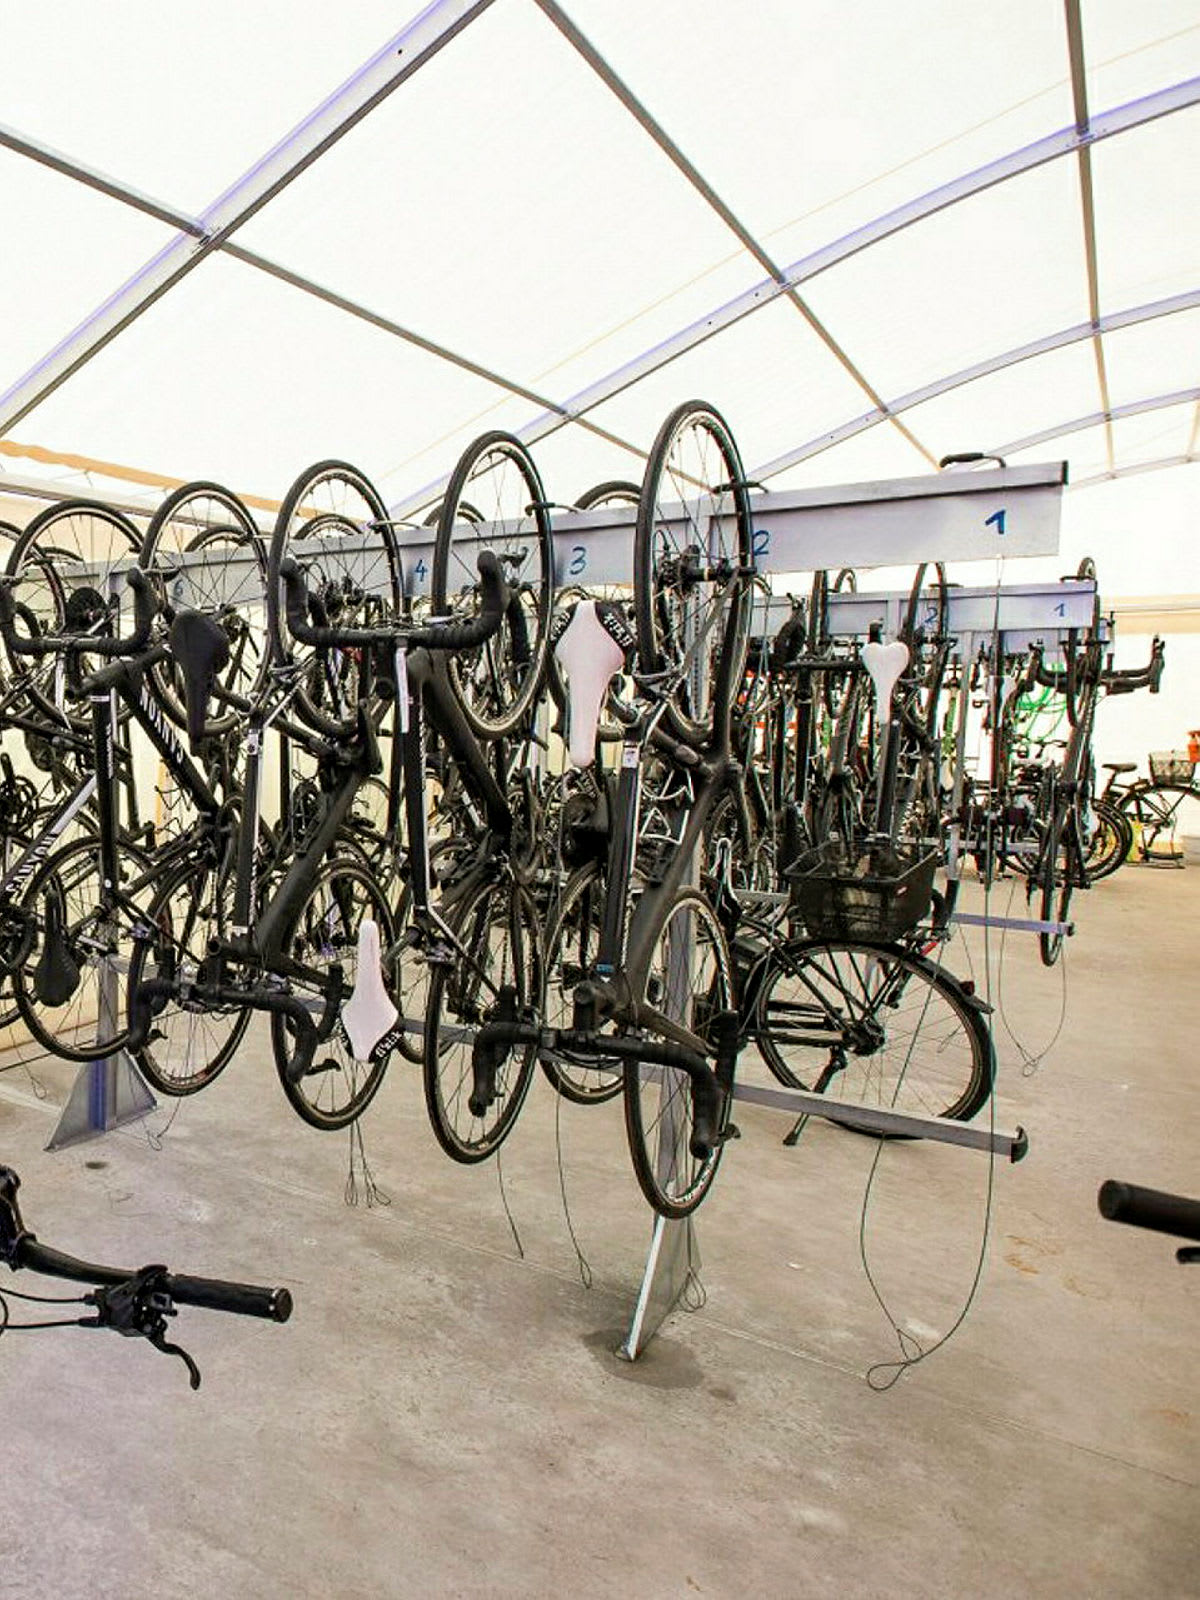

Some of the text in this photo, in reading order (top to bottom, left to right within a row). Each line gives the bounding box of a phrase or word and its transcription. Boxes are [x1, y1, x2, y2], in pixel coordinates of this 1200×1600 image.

[985, 510, 1006, 535] 1
[752, 530, 770, 556] 2
[414, 559, 428, 582] 4
[569, 546, 588, 575] 3
[924, 607, 939, 624] 2
[1054, 603, 1066, 617] 1
